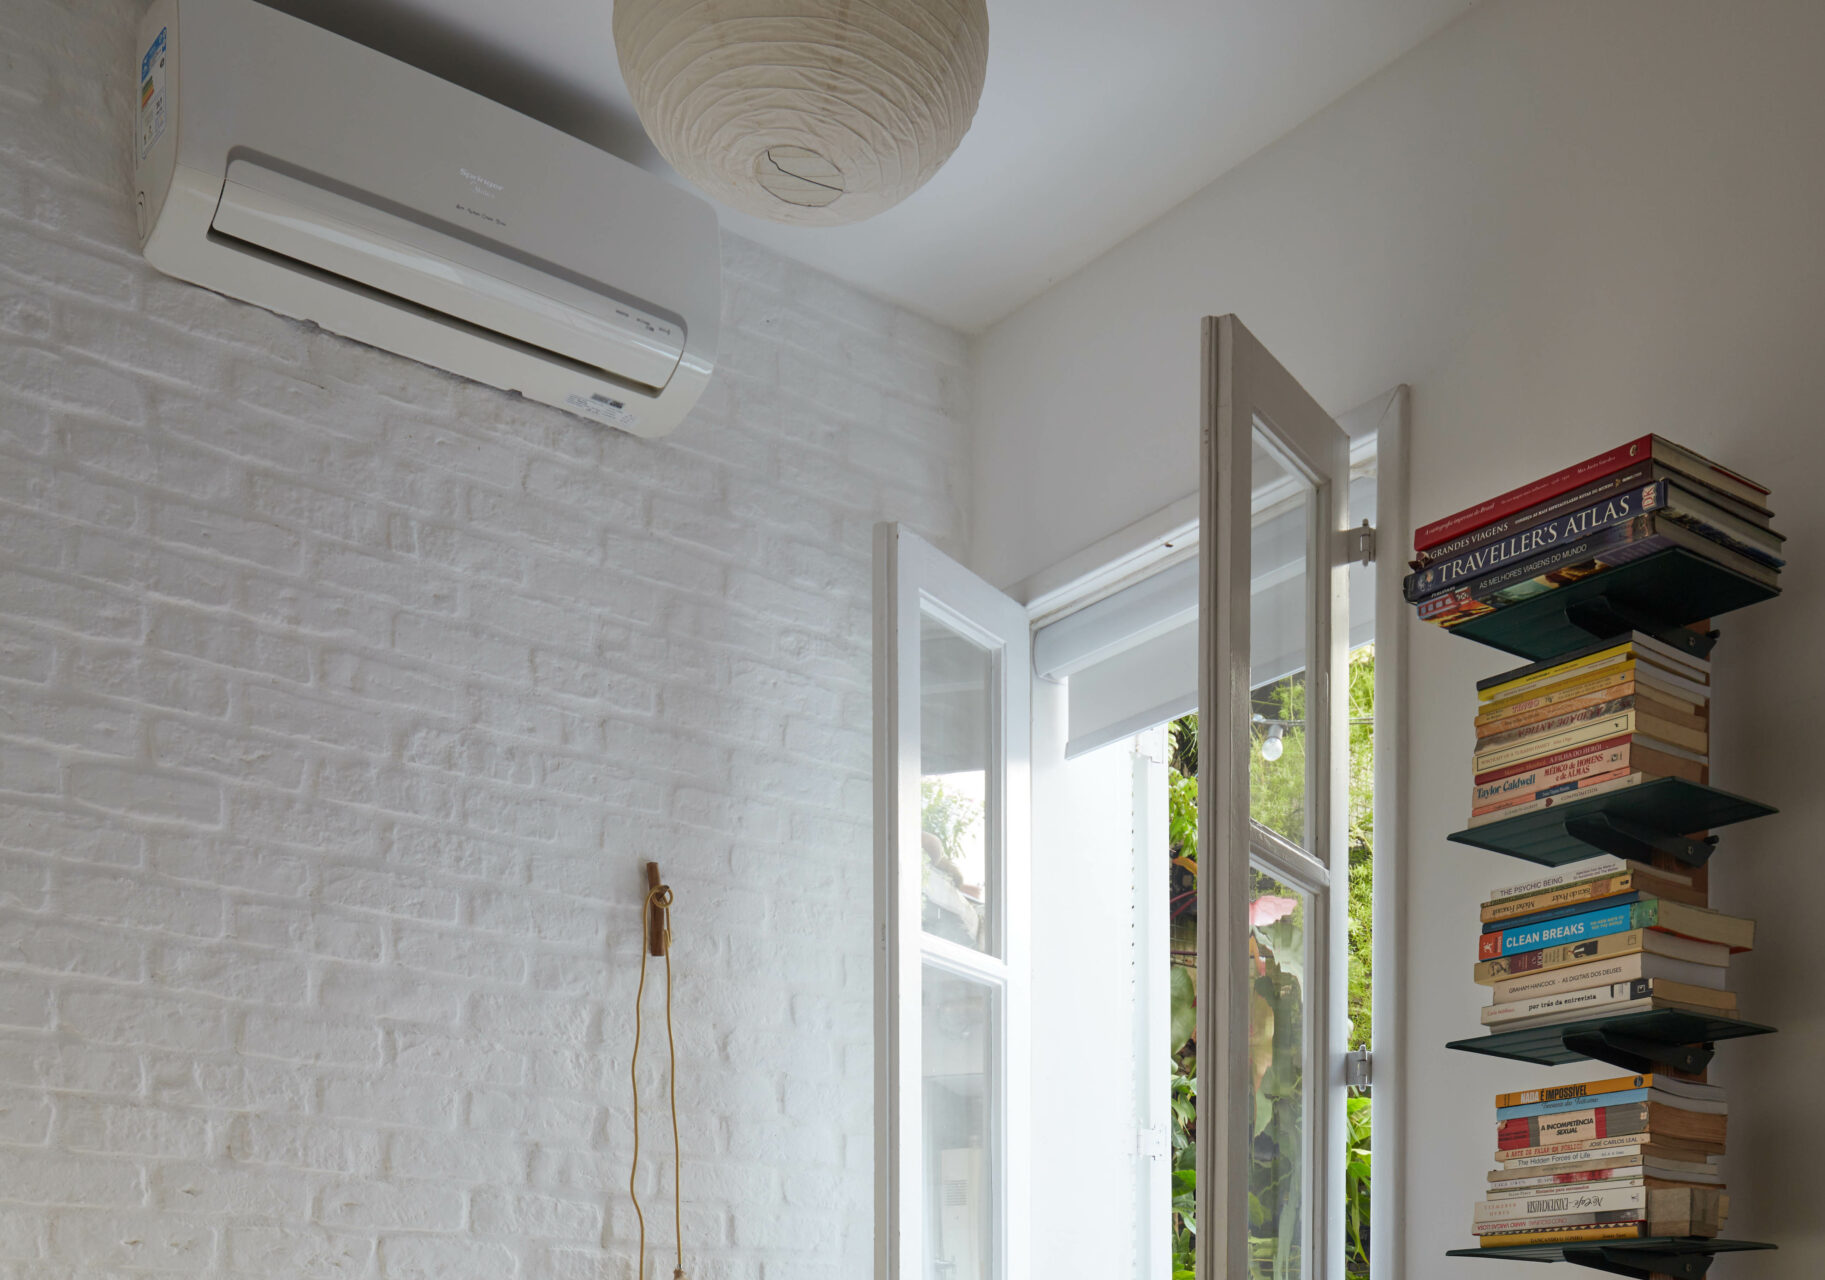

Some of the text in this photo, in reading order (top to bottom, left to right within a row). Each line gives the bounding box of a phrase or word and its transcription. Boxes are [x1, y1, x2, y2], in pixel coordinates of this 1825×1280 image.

[1643, 486, 1655, 507] DK
[1431, 522, 1508, 559] GRANDES VIAGENS
[1439, 522, 1558, 583] TRAVELLER'S
[1563, 495, 1630, 538] ATLAS
[1479, 543, 1587, 589] AS MELHORES VIAGENS DO MUNDO
[1544, 764, 1568, 777] MÉDICO
[1569, 761, 1576, 769] de
[1577, 753, 1604, 768] HOMENS
[1560, 771, 1568, 781] de
[1568, 766, 1590, 778] ALMAS
[1477, 774, 1536, 799] Taylor Caldwell
[1500, 876, 1563, 898] THE PSYCHIC BEING
[1506, 932, 1540, 949] CLEAN
[1542, 922, 1585, 941] BREAKS
[1508, 984, 1529, 994] GRAHAM
[1530, 979, 1555, 991] HANCOCK
[1569, 973, 1589, 983] DIGITAIS
[1590, 970, 1602, 979] DOS
[1528, 994, 1597, 1011] por trás da entrevista
[1520, 1091, 1539, 1104] NADA
[1540, 1088, 1544, 1101] É
[1545, 1084, 1587, 1100] IMPOSSÍVEL
[1546, 1118, 1594, 1131] INCOMPETÊNCIA
[1556, 1127, 1578, 1136] SEXUAL
[1511, 1149, 1523, 1157] ARTE
[1534, 1146, 1550, 1155] FALAR
[1589, 1139, 1602, 1148] JOSÉ
[1603, 1138, 1624, 1146] CARLOS
[1530, 1156, 1550, 1165] Hidden
[1552, 1154, 1571, 1162] Forces
[1580, 1151, 1591, 1159] Life
[1573, 1196, 1591, 1208] Café
